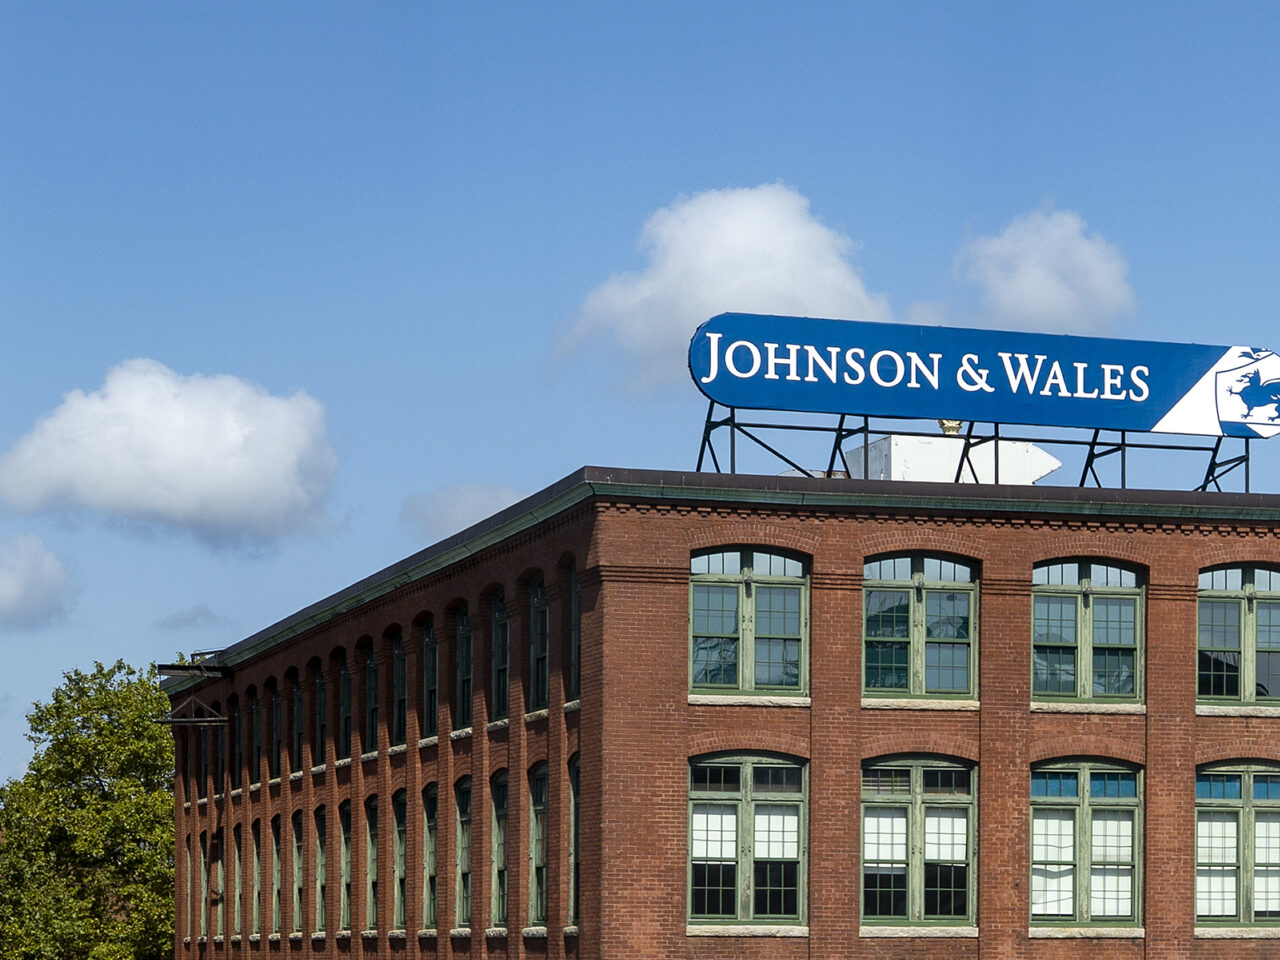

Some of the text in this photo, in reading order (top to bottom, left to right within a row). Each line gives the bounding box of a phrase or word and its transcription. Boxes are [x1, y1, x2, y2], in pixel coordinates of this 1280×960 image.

[701, 332, 1150, 402] JOHNSON & WALES
